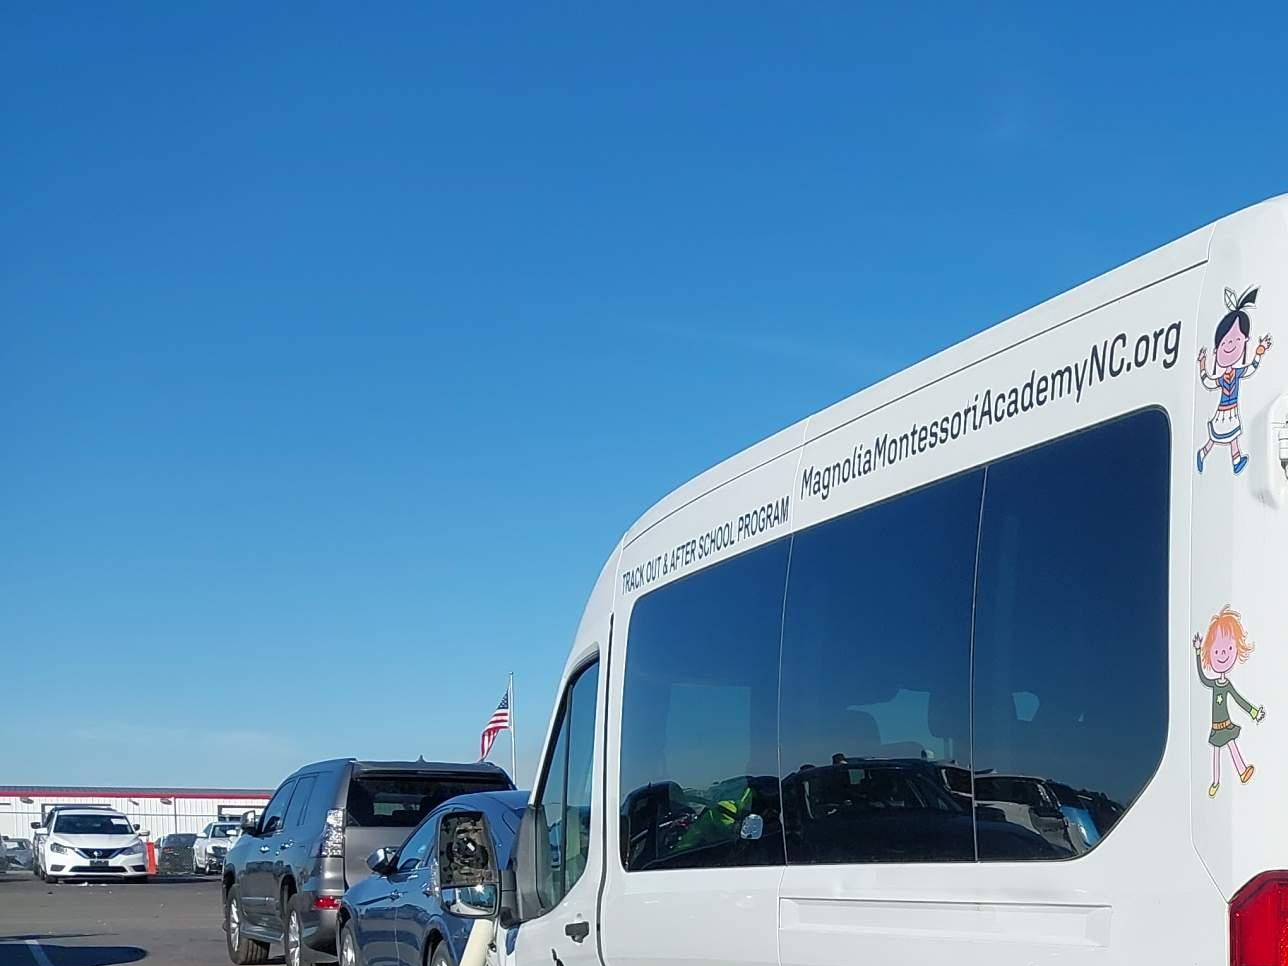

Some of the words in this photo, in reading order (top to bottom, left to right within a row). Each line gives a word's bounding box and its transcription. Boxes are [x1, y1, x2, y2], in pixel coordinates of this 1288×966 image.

[800, 320, 1182, 501] MagnoliaMontessoriAcademyNC.org
[622, 561, 646, 595] TRACK
[646, 556, 662, 583] OUT
[662, 553, 668, 575] &
[669, 539, 696, 573] AFTER
[698, 521, 735, 560] SCHOOL
[737, 495, 790, 542] PROGRAM
